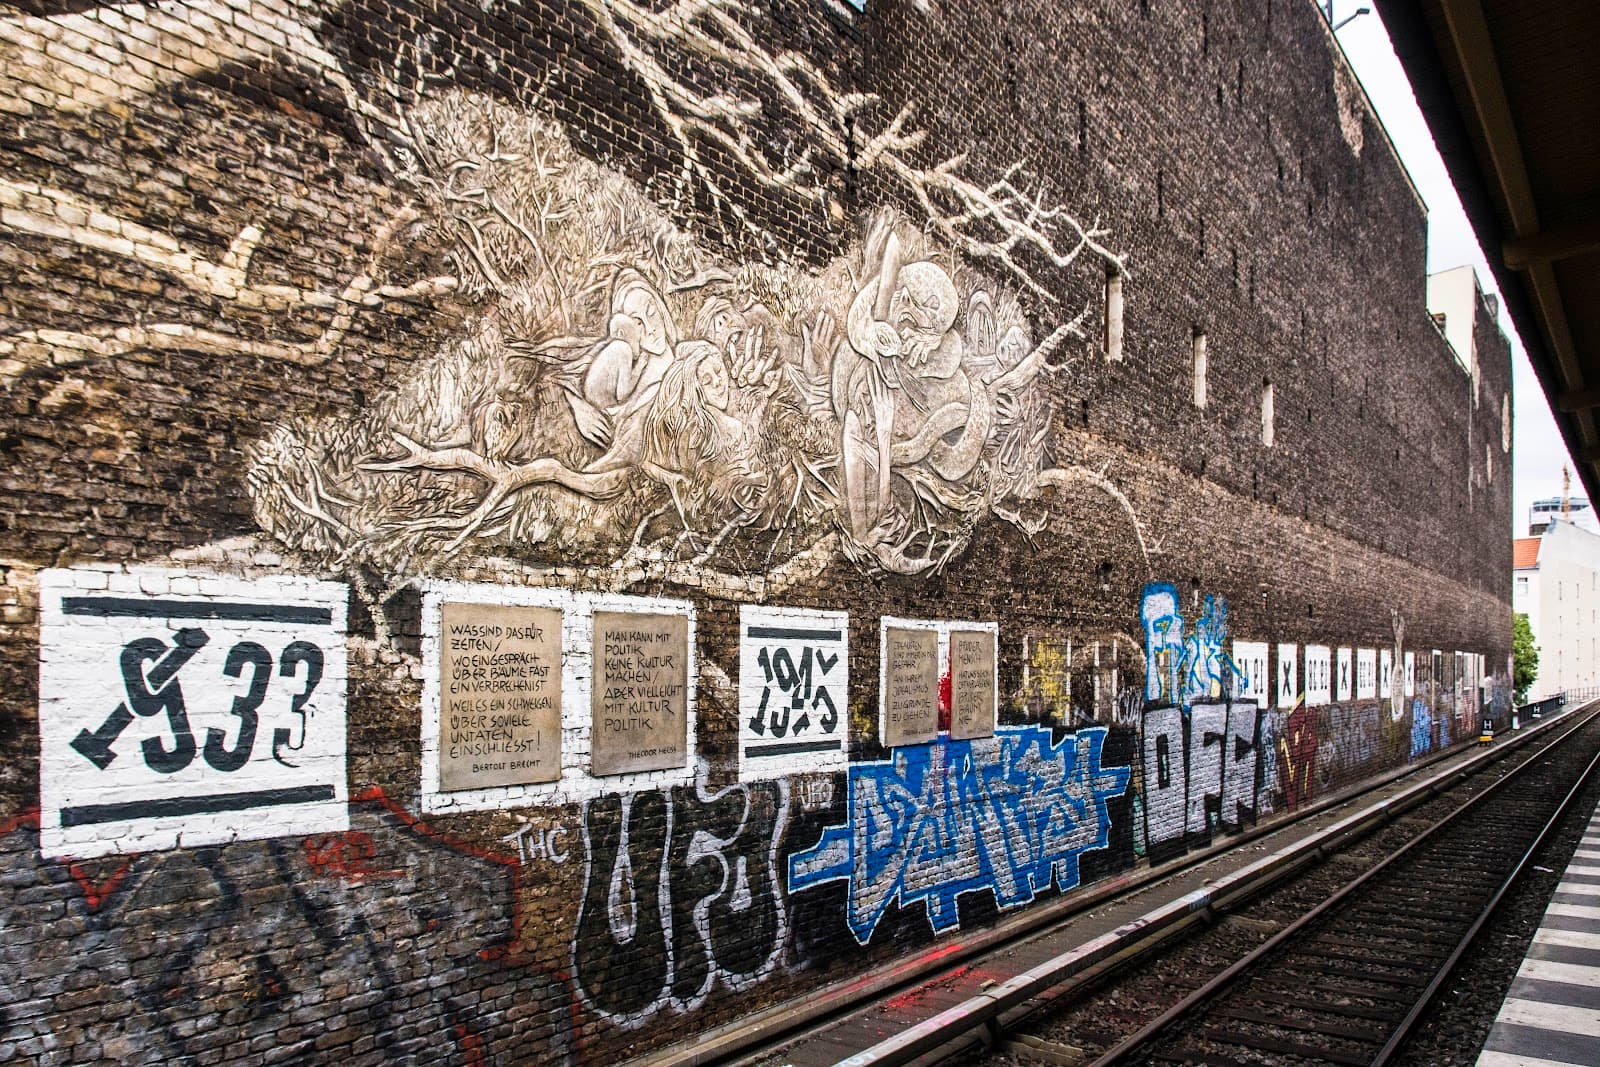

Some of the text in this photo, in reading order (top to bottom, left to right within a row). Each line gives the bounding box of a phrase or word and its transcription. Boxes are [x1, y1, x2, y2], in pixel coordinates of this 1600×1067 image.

[450, 622, 544, 643] WAS SIND DAS FÜR
[605, 631, 671, 643] MAN KANN MIT
[604, 644, 645, 657] POLITIK
[451, 651, 540, 667] WO EIN GESPRÄCH
[604, 655, 674, 670] KEINE KULTUR
[452, 665, 550, 681] ÜBER BÄUME FAST
[450, 680, 547, 694] EIN VERBRECHEN IST
[603, 685, 683, 699] ABER VIELLEICHT
[450, 696, 552, 712] WEIL ES EIN SCHWEIGEN
[604, 700, 675, 716] MIT KULTUR
[450, 714, 487, 730] ÜBER
[903, 709, 930, 721] GEHEN
[604, 718, 653, 732] POLITIK
[450, 728, 513, 743] UNTATEN
[628, 749, 657, 759] THEODOR
[472, 759, 541, 773] BERTOLT BRECHT
[502, 815, 570, 864] THC
